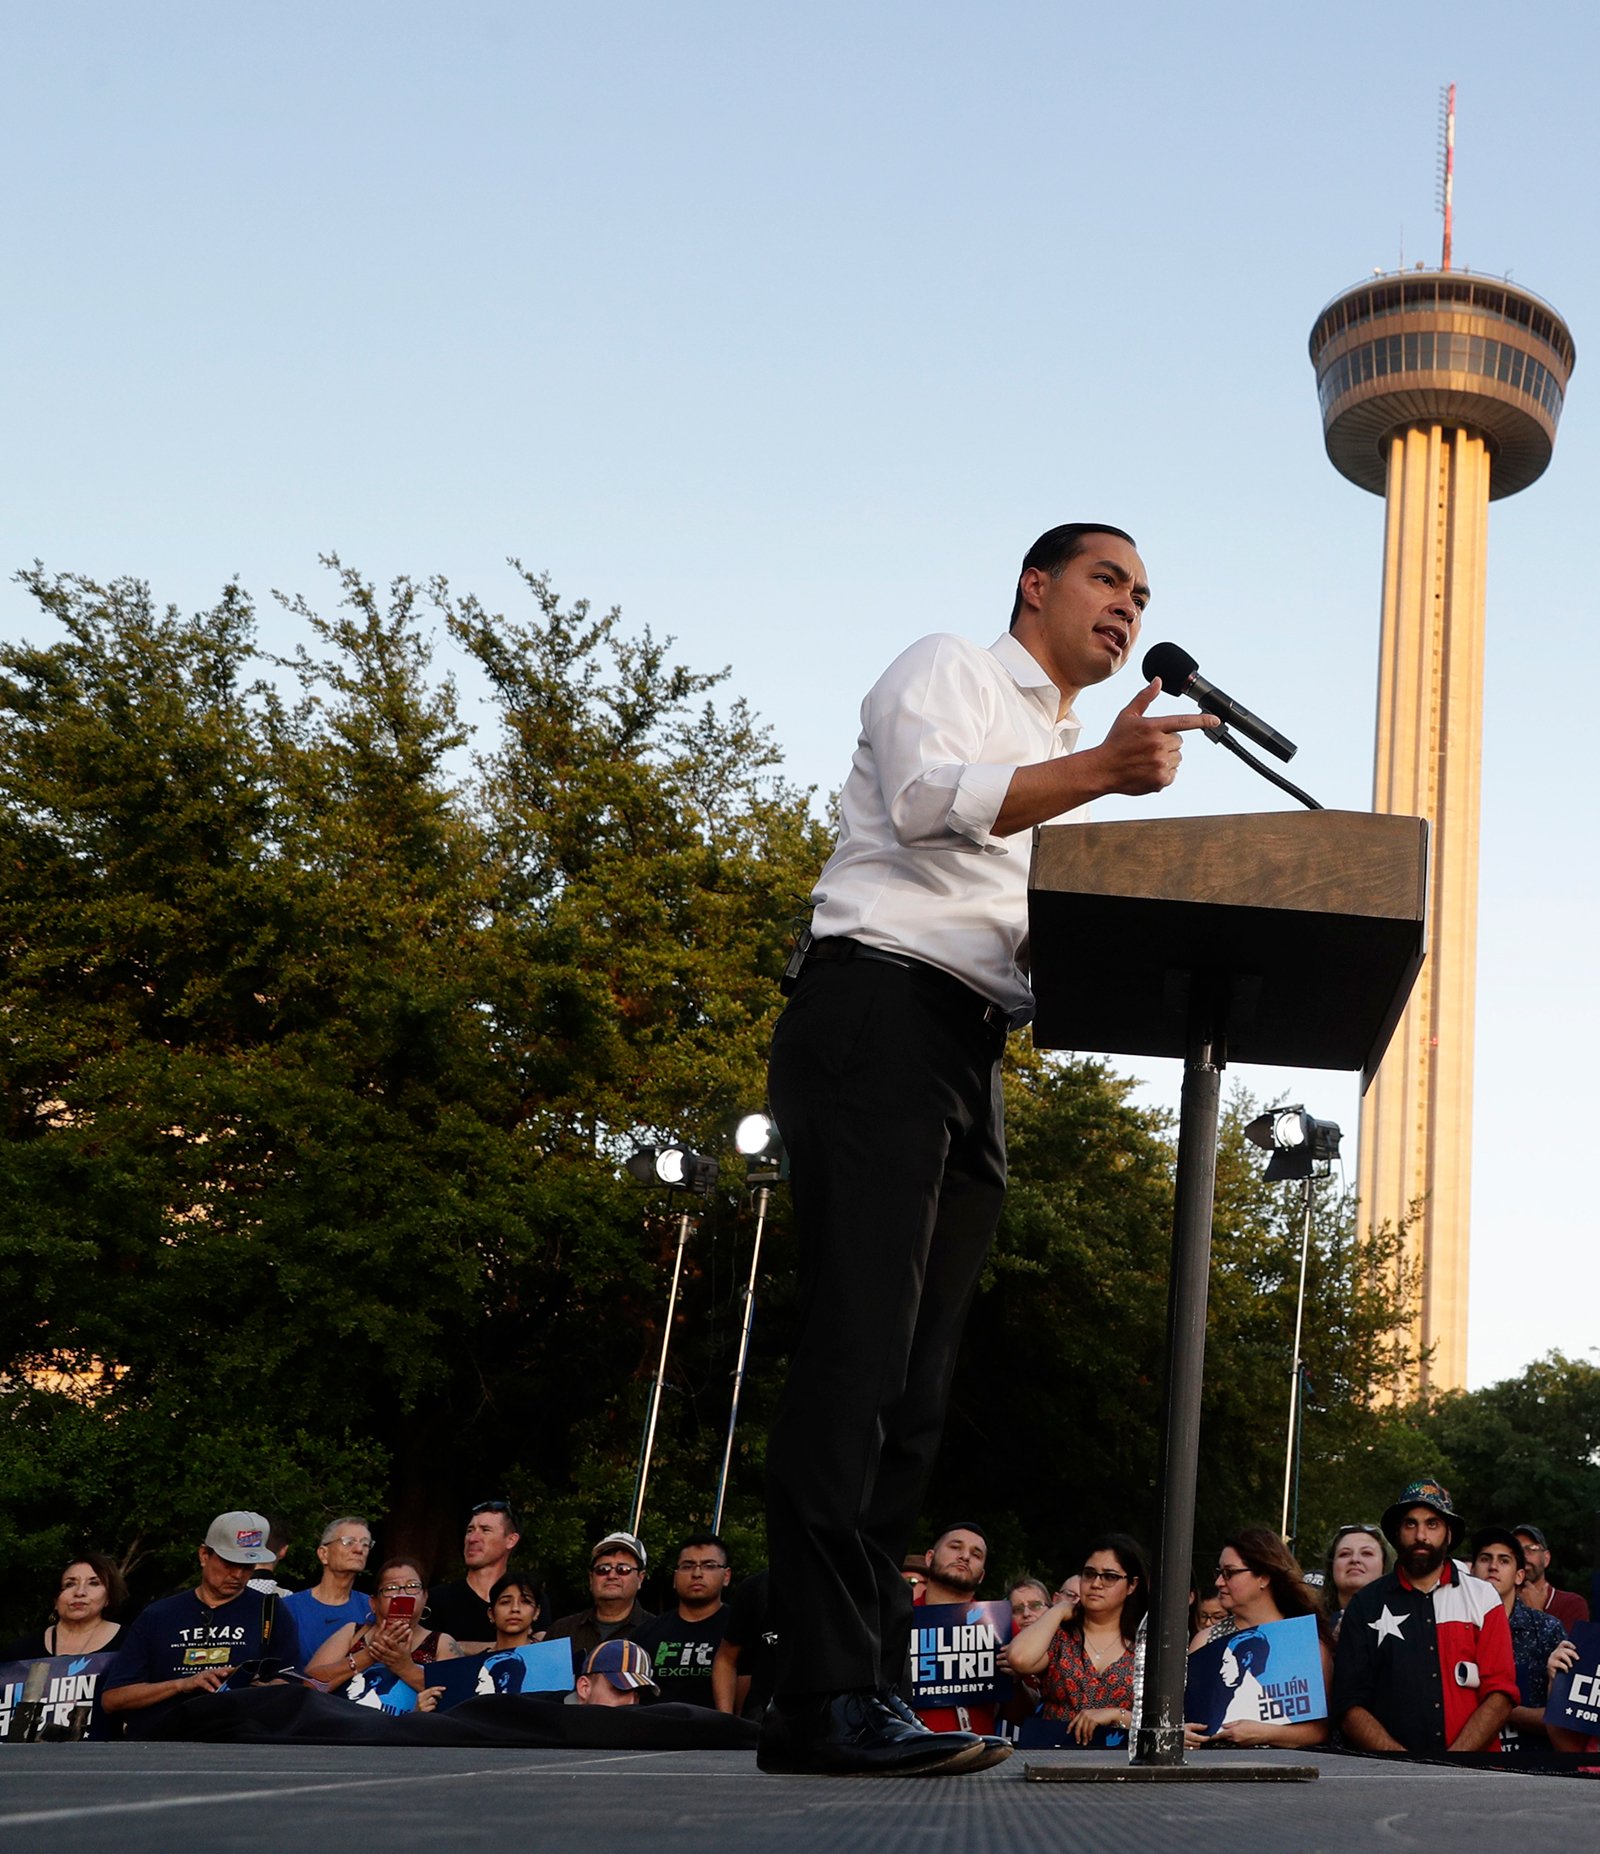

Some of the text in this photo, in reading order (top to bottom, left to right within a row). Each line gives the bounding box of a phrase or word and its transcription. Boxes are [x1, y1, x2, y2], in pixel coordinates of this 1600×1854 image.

[179, 1625, 245, 1642] TEXAS
[654, 1641, 714, 1666] Fit
[910, 1651, 995, 1683] STRO
[919, 1683, 985, 1696] PRESIDENT
[1258, 1675, 1309, 1700] JULIÁN
[1259, 1696, 1311, 1721] 2020
[1576, 1709, 1599, 1723] FOR
